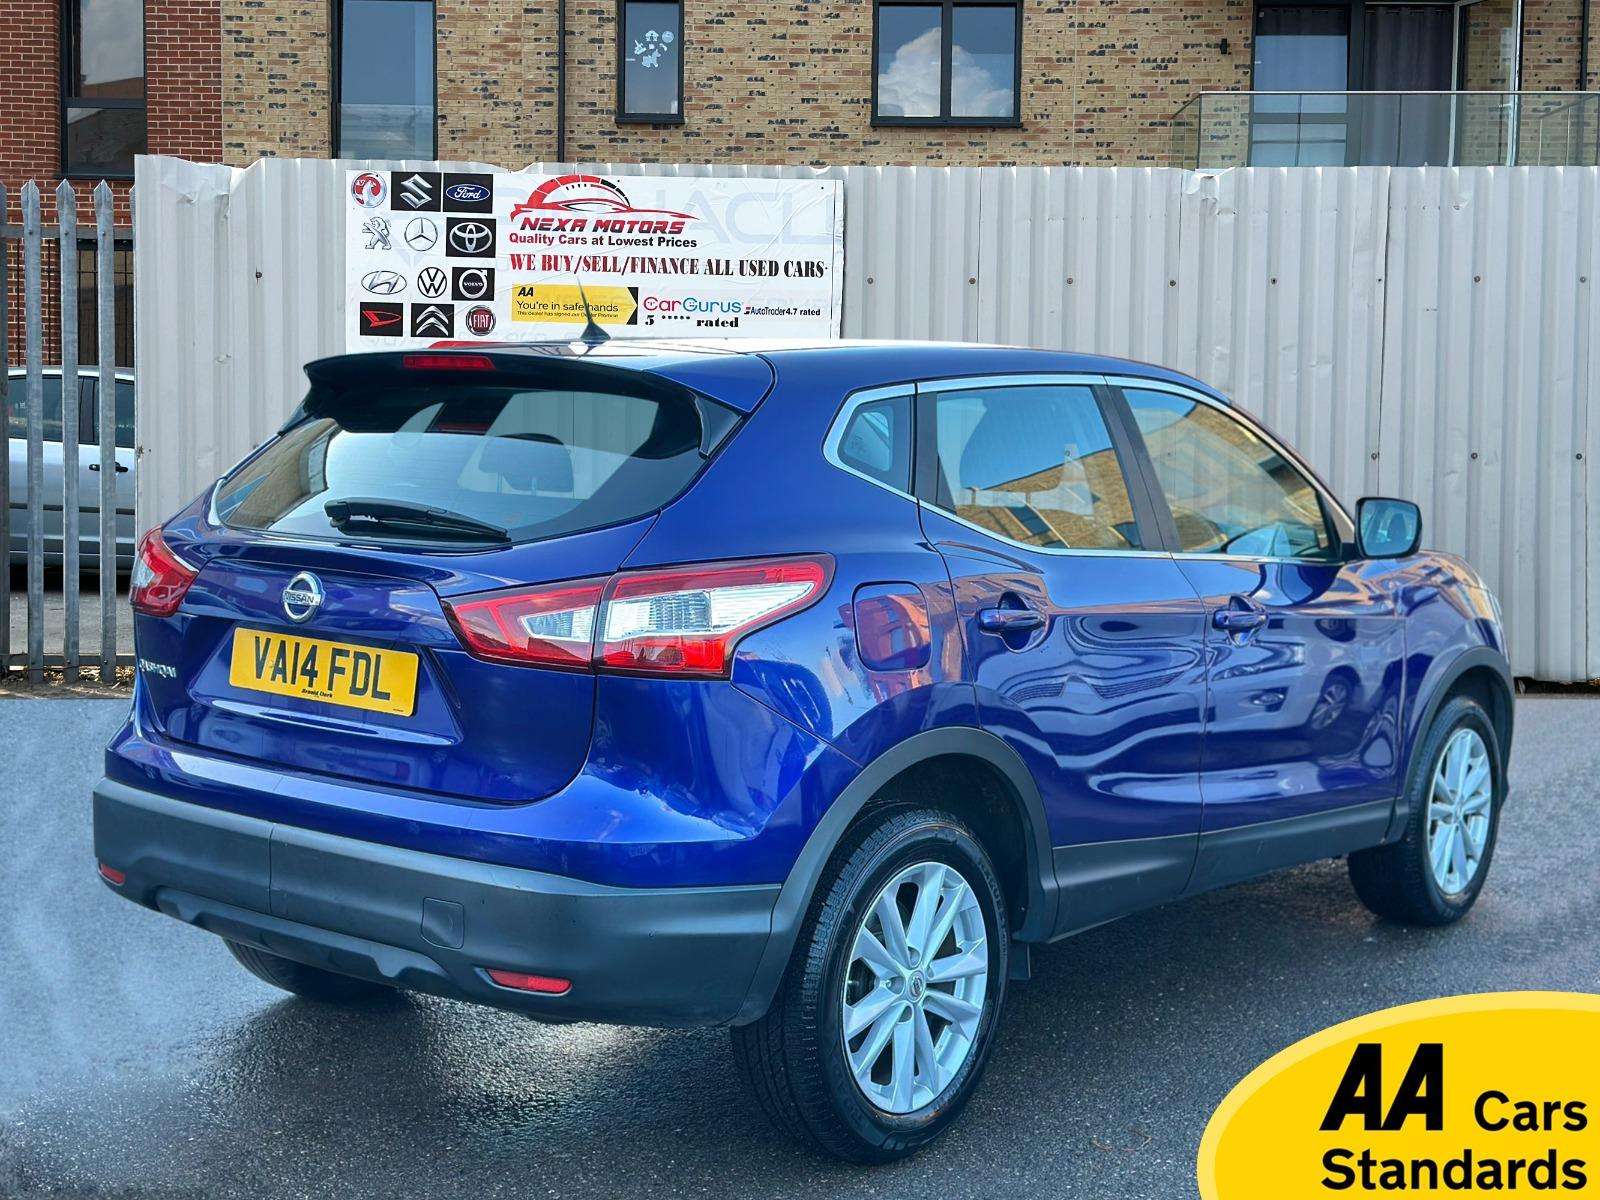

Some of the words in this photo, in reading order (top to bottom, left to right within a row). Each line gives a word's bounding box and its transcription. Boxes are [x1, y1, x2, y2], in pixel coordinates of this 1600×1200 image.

[454, 186, 482, 199] Ford
[520, 217, 588, 232] NEXA
[592, 219, 686, 234] MOTORS
[509, 232, 555, 246] Quality
[558, 234, 588, 245] Cars
[591, 235, 604, 246] at
[608, 235, 654, 246] Lowest
[657, 236, 698, 247] Prices
[509, 253, 536, 271] WE
[703, 258, 734, 276] ALL
[739, 259, 780, 277] USED
[783, 260, 825, 278] CARS
[517, 286, 534, 297] AA
[516, 300, 549, 310] You're
[551, 302, 560, 310] in
[563, 302, 585, 311] safe
[587, 303, 619, 312] hands
[643, 296, 742, 313] CarGurus
[473, 314, 490, 328] FIAT
[645, 314, 655, 326] 5
[696, 316, 739, 328] rated
[284, 590, 315, 604] NISSAN
[254, 635, 319, 689] VA14
[327, 647, 391, 701] FDL
